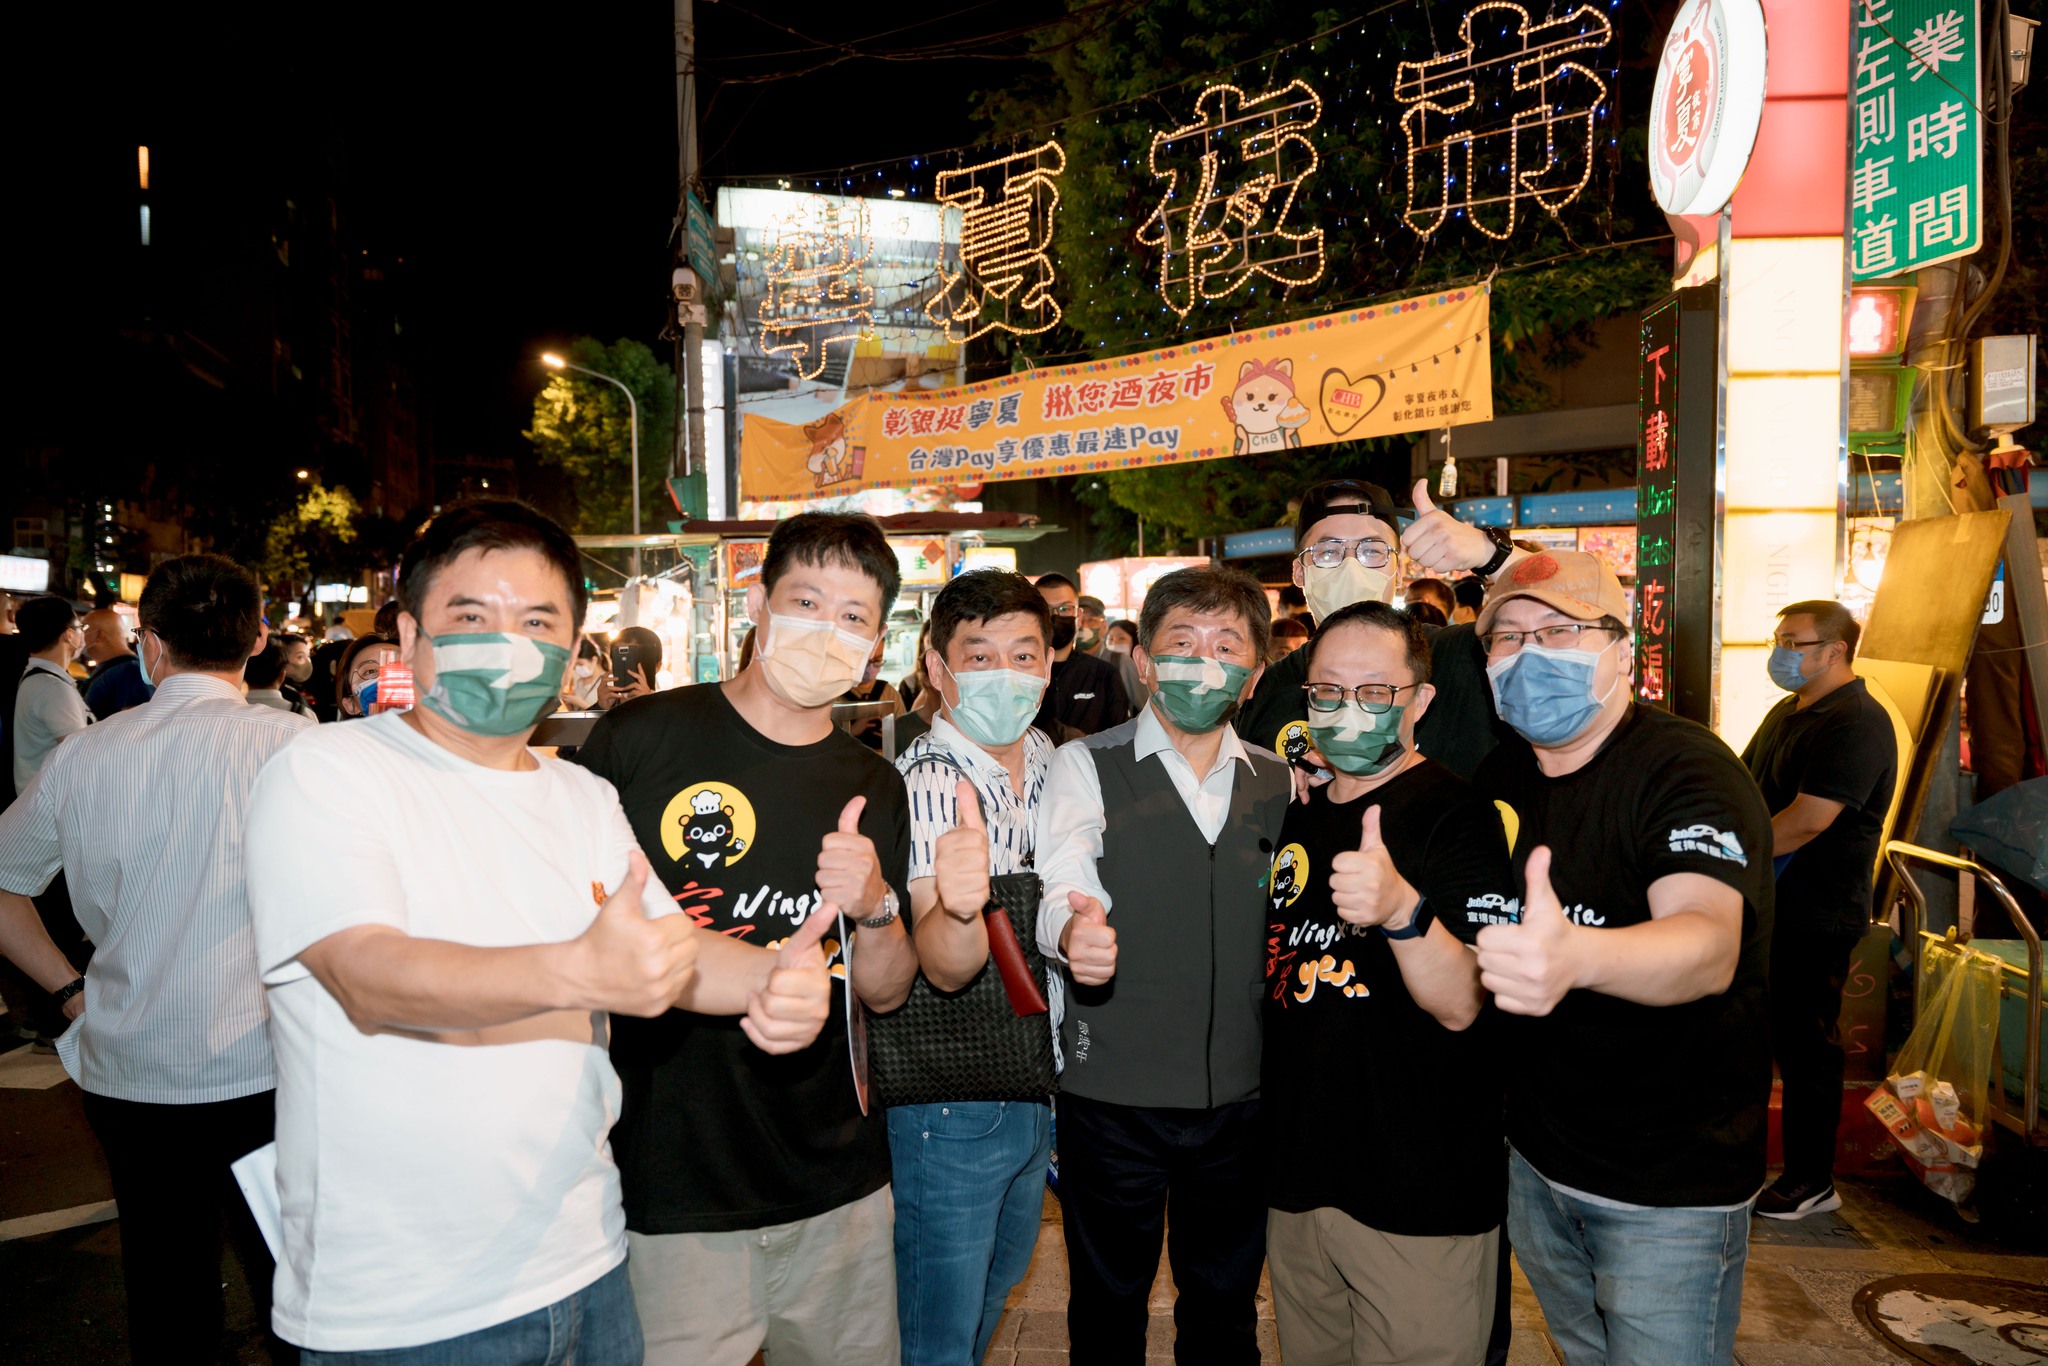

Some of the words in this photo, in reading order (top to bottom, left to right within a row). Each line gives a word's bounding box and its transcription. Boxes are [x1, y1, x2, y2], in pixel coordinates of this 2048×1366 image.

[1671, 47, 1697, 152] 寧夏
[1691, 89, 1702, 130] 夜市
[883, 392, 1023, 437] 彰銀挺寧夏
[1044, 362, 1215, 419] 揪您迺夜市
[1331, 390, 1361, 407] CHB
[1404, 389, 1448, 406] 寧夏夜市
[1645, 344, 1670, 472] 下載
[1251, 434, 1279, 448] CHB
[1640, 484, 1674, 519] Uber
[1640, 534, 1671, 567] Eats
